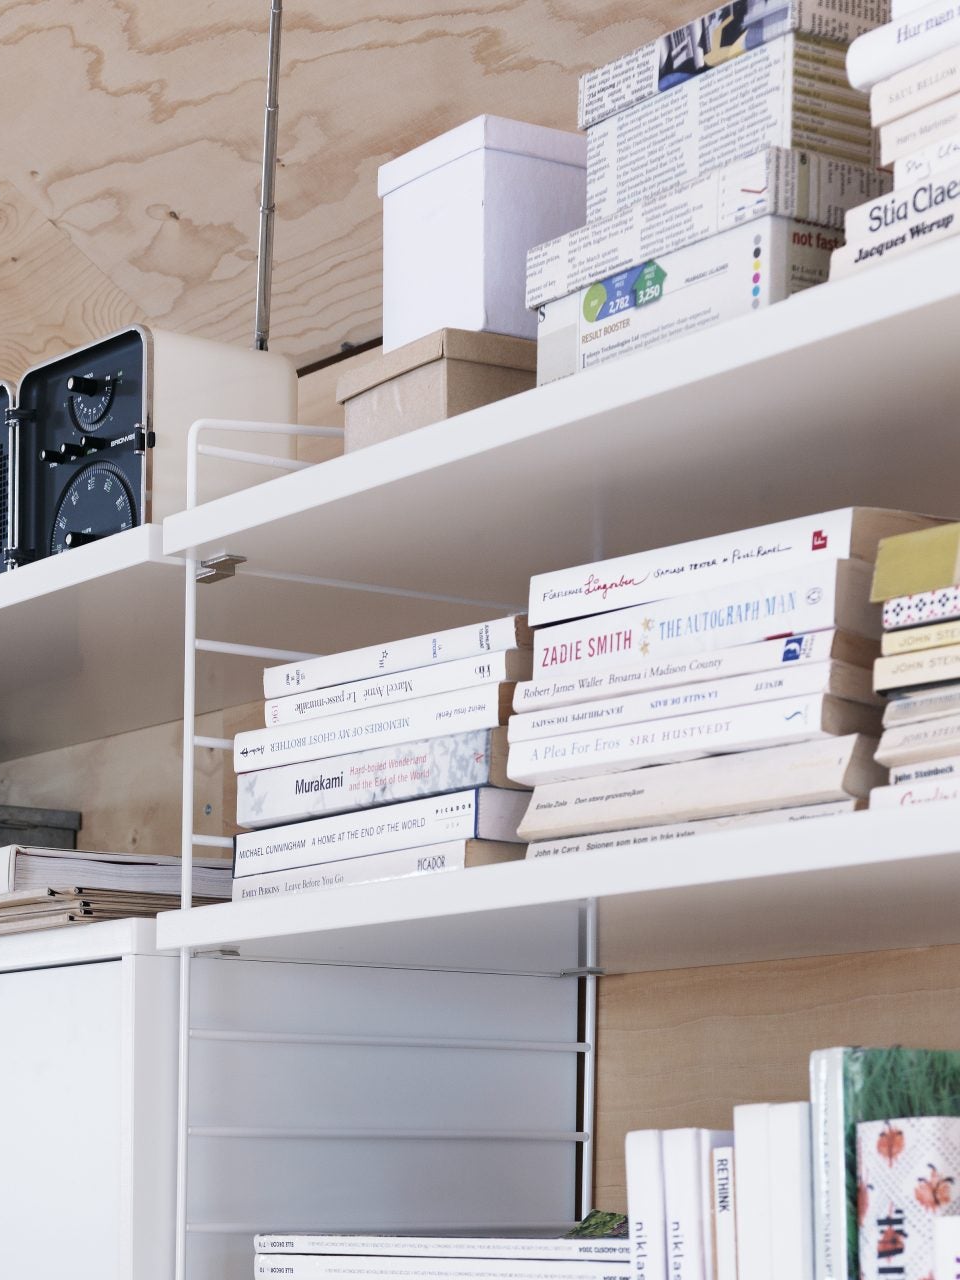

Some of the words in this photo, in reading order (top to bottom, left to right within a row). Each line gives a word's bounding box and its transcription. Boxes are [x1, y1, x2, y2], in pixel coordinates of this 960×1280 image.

[793, 231, 812, 246] not
[854, 235, 906, 263] Jacques
[909, 214, 954, 239] Werup
[639, 285, 660, 303] 3,250
[609, 296, 629, 314] 2,782
[582, 328, 603, 344] RESULT
[604, 318, 631, 336] BOOSTER
[689, 559, 717, 572] TEXTER
[659, 618, 682, 641] THE
[688, 602, 760, 636] AUTOGRAPH
[764, 590, 797, 616] MAN
[542, 640, 582, 668] ZADIE
[587, 629, 632, 657] SMITH
[523, 685, 550, 699] Robert
[552, 681, 575, 697] James
[578, 677, 603, 690] Waller
[649, 663, 687, 678] Madison
[689, 658, 723, 671] County
[364, 717, 410, 736] MEMORIES
[270, 734, 306, 753] BROTHER
[306, 729, 335, 746] GHOST
[530, 748, 539, 761] A
[543, 743, 567, 759] Plea
[571, 740, 591, 755] For
[595, 737, 620, 751] Eros
[630, 733, 656, 747] SIRI
[661, 721, 732, 742] HUSTVEDT
[388, 754, 427, 769] Wonderland
[295, 771, 344, 796] Murakami
[348, 780, 360, 791] and
[362, 778, 373, 789] the
[374, 776, 388, 788] End
[398, 773, 408, 784] the
[410, 768, 430, 783] World
[436, 803, 472, 814] PICADOR
[239, 847, 264, 859] MICHAEL
[266, 839, 306, 856] CUNNINGHAM
[312, 836, 317, 846] A
[317, 834, 336, 845] HOME
[338, 832, 346, 842] AT
[347, 829, 359, 841] THE
[360, 826, 375, 838] END
[376, 825, 386, 835] OF
[387, 822, 400, 833] THE
[401, 818, 426, 831] WORLD
[534, 849, 551, 859] John
[616, 838, 631, 846] som
[633, 836, 648, 844] kom
[417, 855, 446, 872] PICADOR
[284, 881, 301, 893] Leave
[302, 877, 321, 891] Before
[322, 876, 333, 886] You
[334, 874, 344, 884] Go
[717, 1158, 730, 1213] RETHINK
